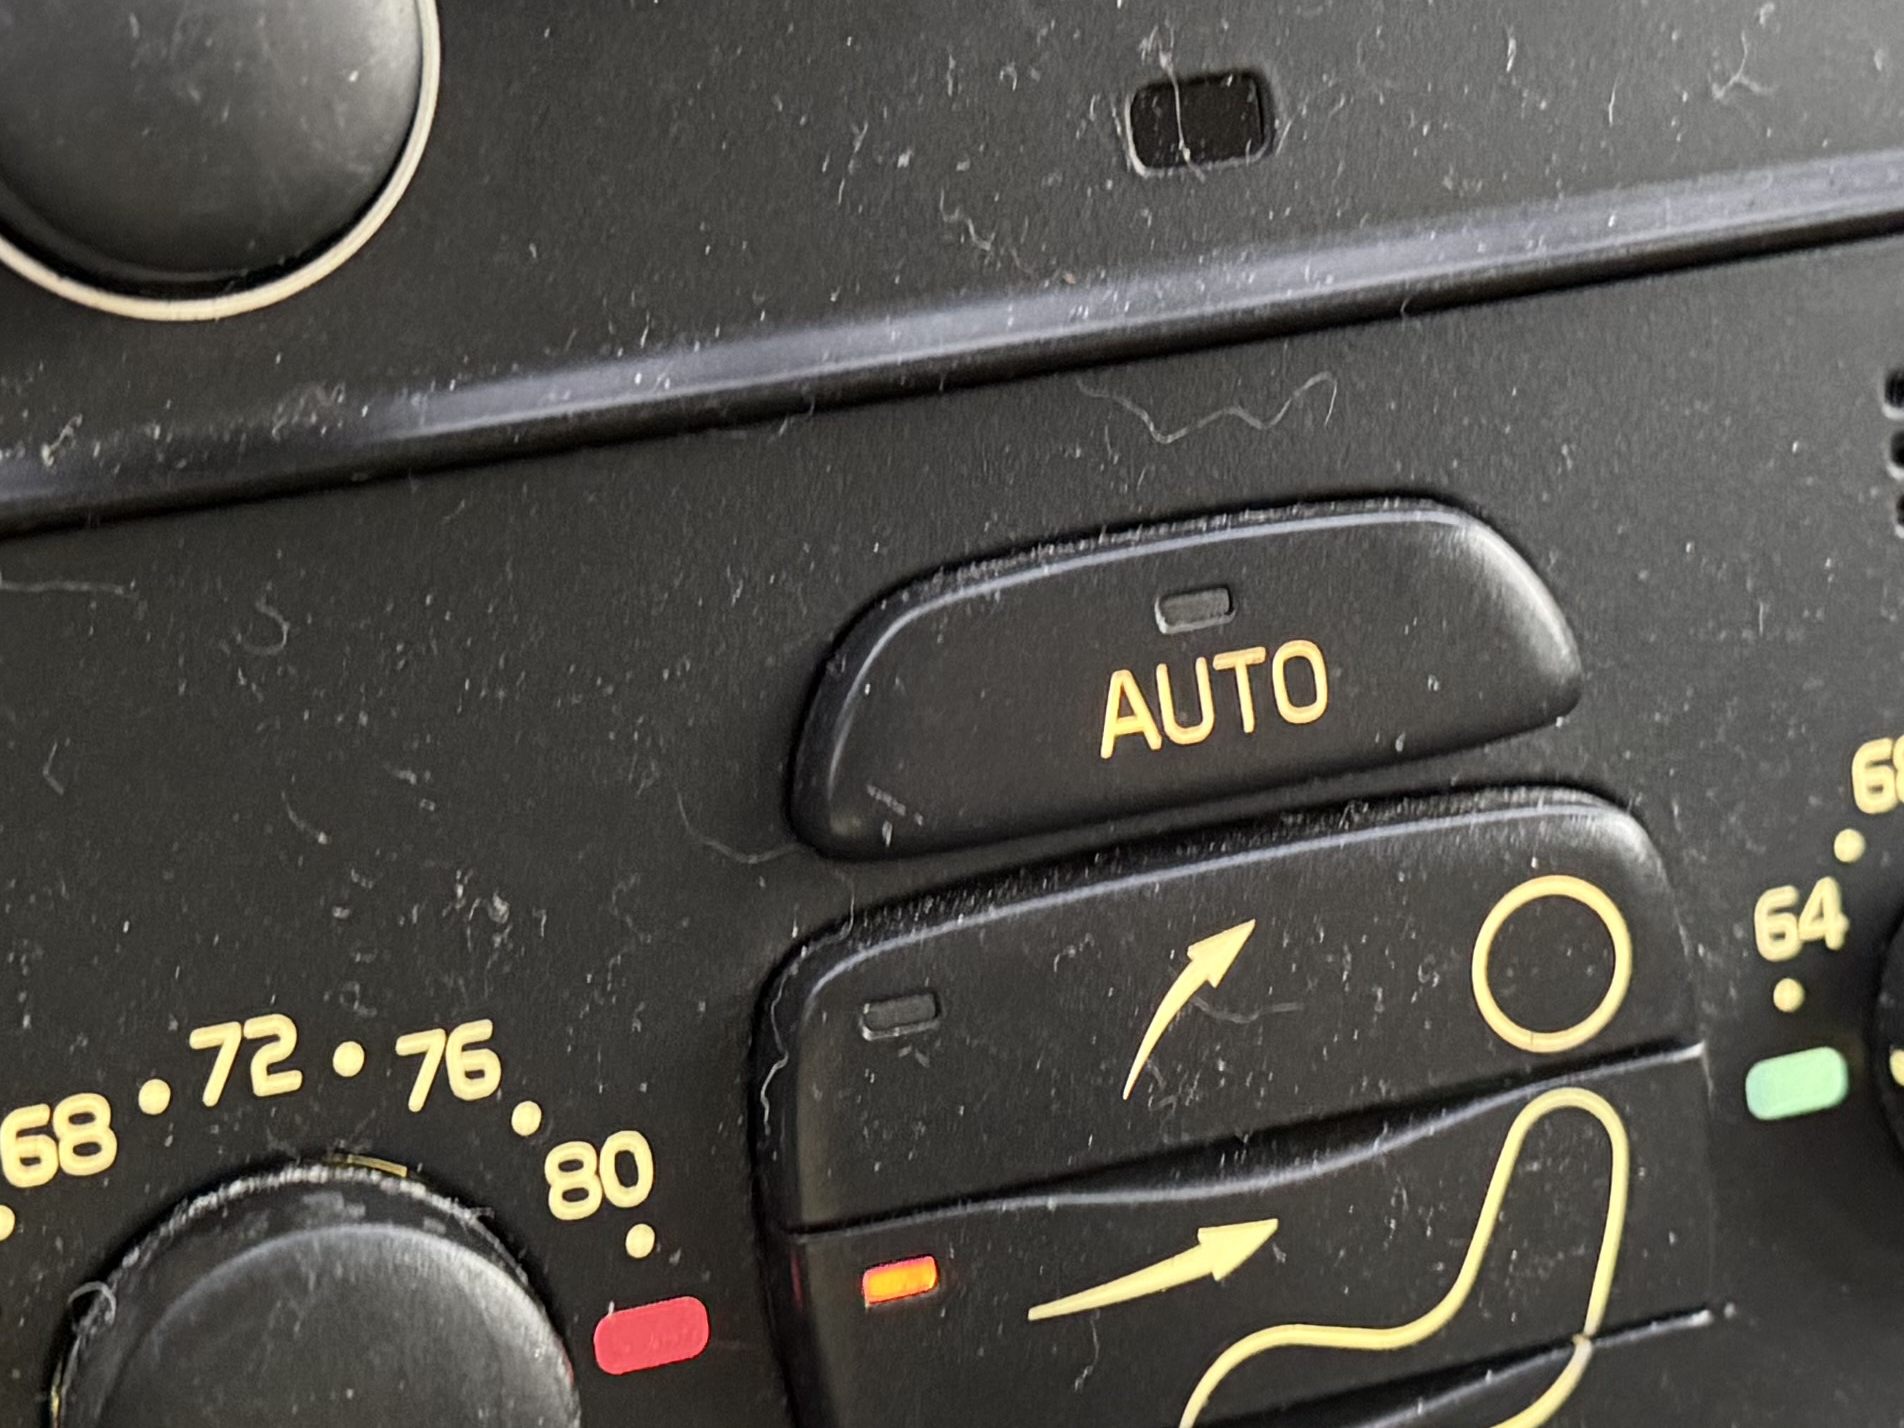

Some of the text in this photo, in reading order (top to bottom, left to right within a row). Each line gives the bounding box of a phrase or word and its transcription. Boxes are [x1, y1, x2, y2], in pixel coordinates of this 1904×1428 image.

[1100, 639, 1329, 759] AUTO
[1754, 876, 1849, 962] 64
[189, 1013, 303, 1107] 72
[395, 1019, 501, 1112] 76
[543, 1130, 655, 1221] 80
